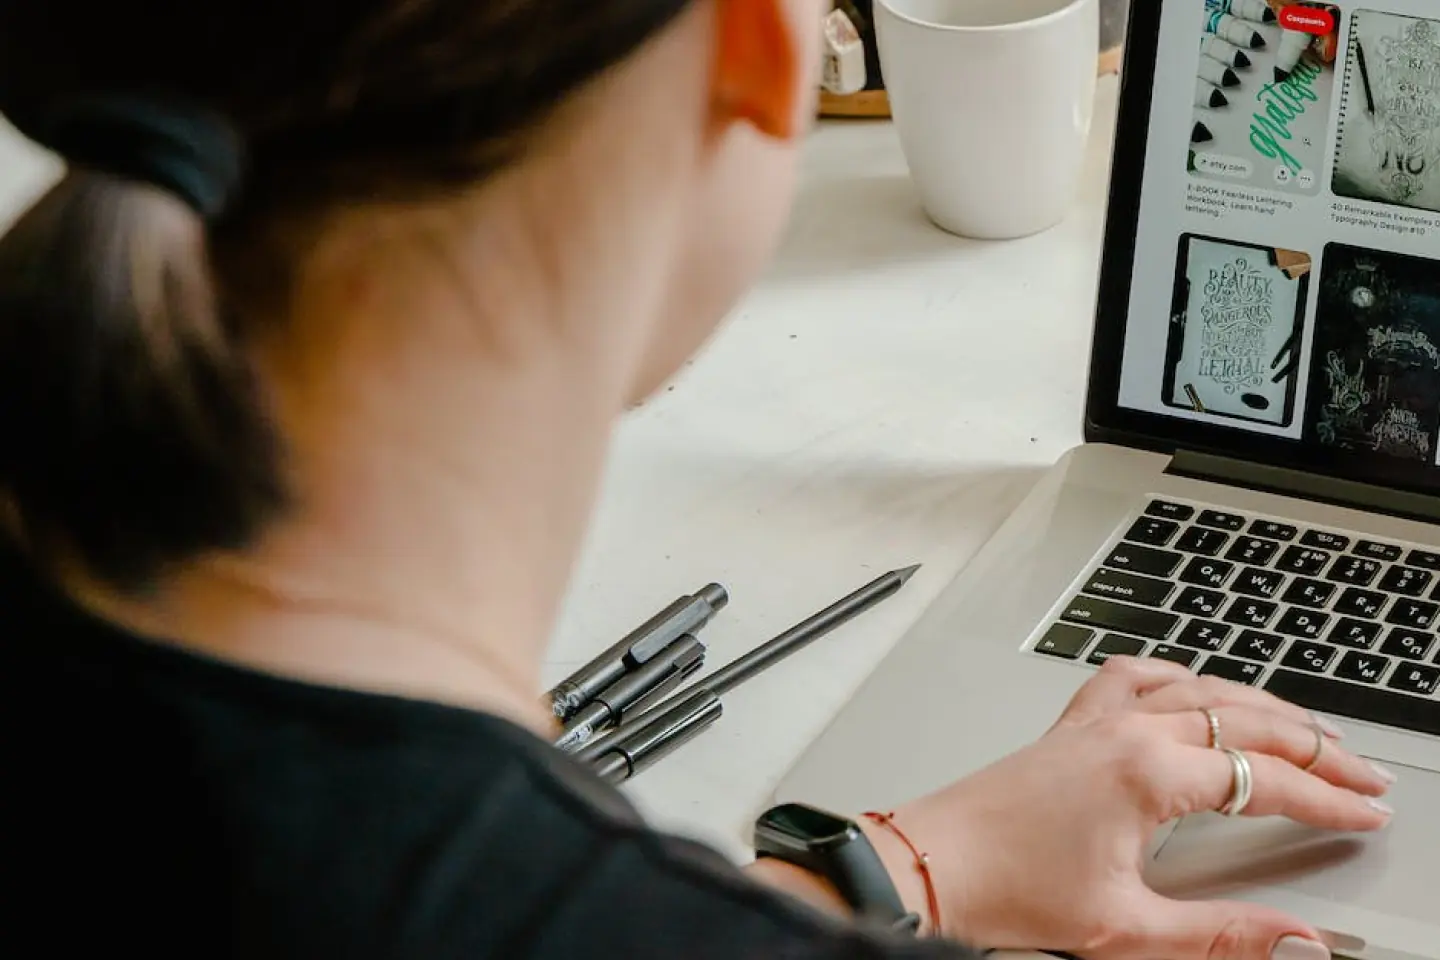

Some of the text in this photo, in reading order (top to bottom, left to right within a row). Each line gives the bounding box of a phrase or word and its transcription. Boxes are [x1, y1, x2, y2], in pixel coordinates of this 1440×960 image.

[1209, 160, 1247, 172] etsy.com
[1331, 202, 1343, 211] 40
[1344, 204, 1392, 218] Remarkable
[1201, 566, 1213, 576] Q
[1251, 576, 1267, 585] W
[1115, 586, 1133, 595] lock
[1304, 586, 1315, 596] E
[1192, 596, 1204, 605] A
[1356, 597, 1367, 606] R
[1245, 606, 1256, 615] S
[1296, 616, 1309, 625] D
[1198, 628, 1212, 638] Z
[1350, 627, 1362, 635] F
[1250, 639, 1265, 649] X
[1304, 649, 1316, 659] C
[1359, 660, 1369, 670] V
[1409, 671, 1421, 680] B
